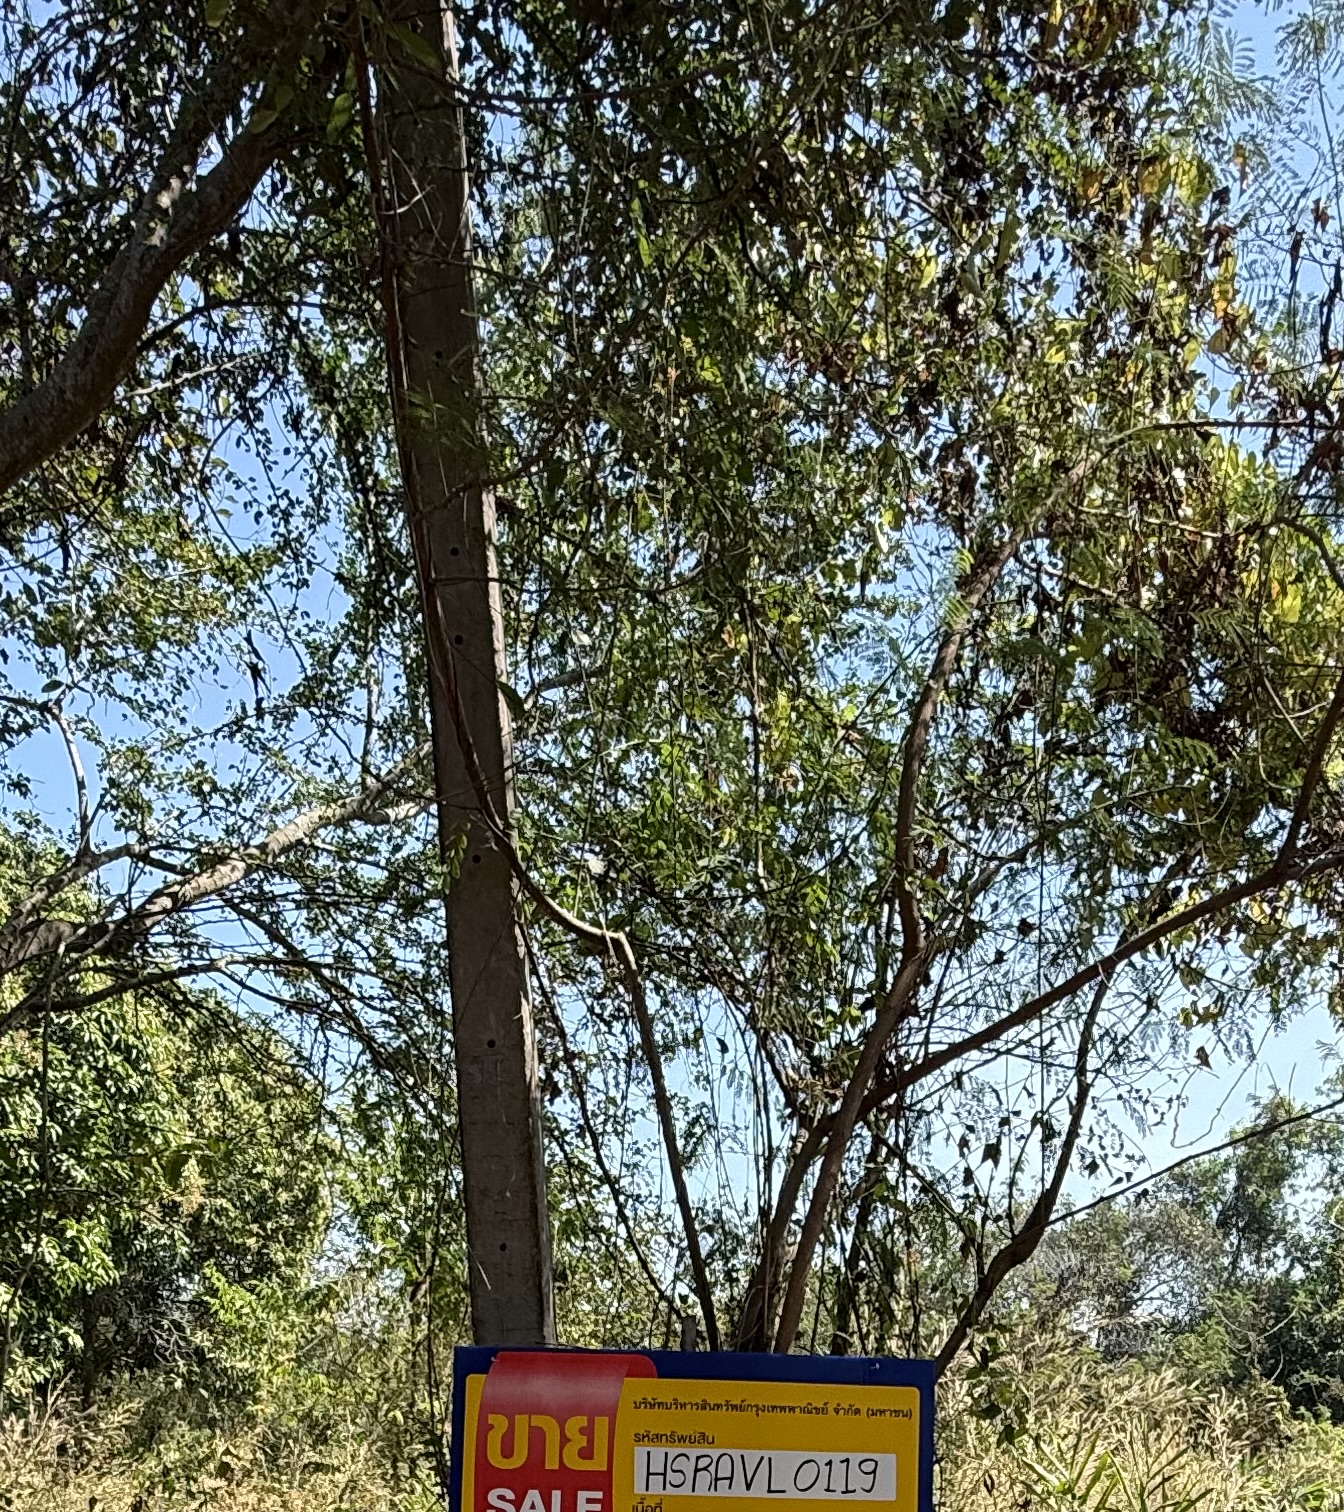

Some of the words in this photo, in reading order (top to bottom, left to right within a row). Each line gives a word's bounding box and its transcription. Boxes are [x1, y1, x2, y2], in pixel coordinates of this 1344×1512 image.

[833, 1402, 861, 1417] จำกัด
[866, 1407, 913, 1420] (มหาชน)
[487, 1414, 609, 1471] ขาย
[633, 1430, 715, 1446] รหัสทรัพย์สิน
